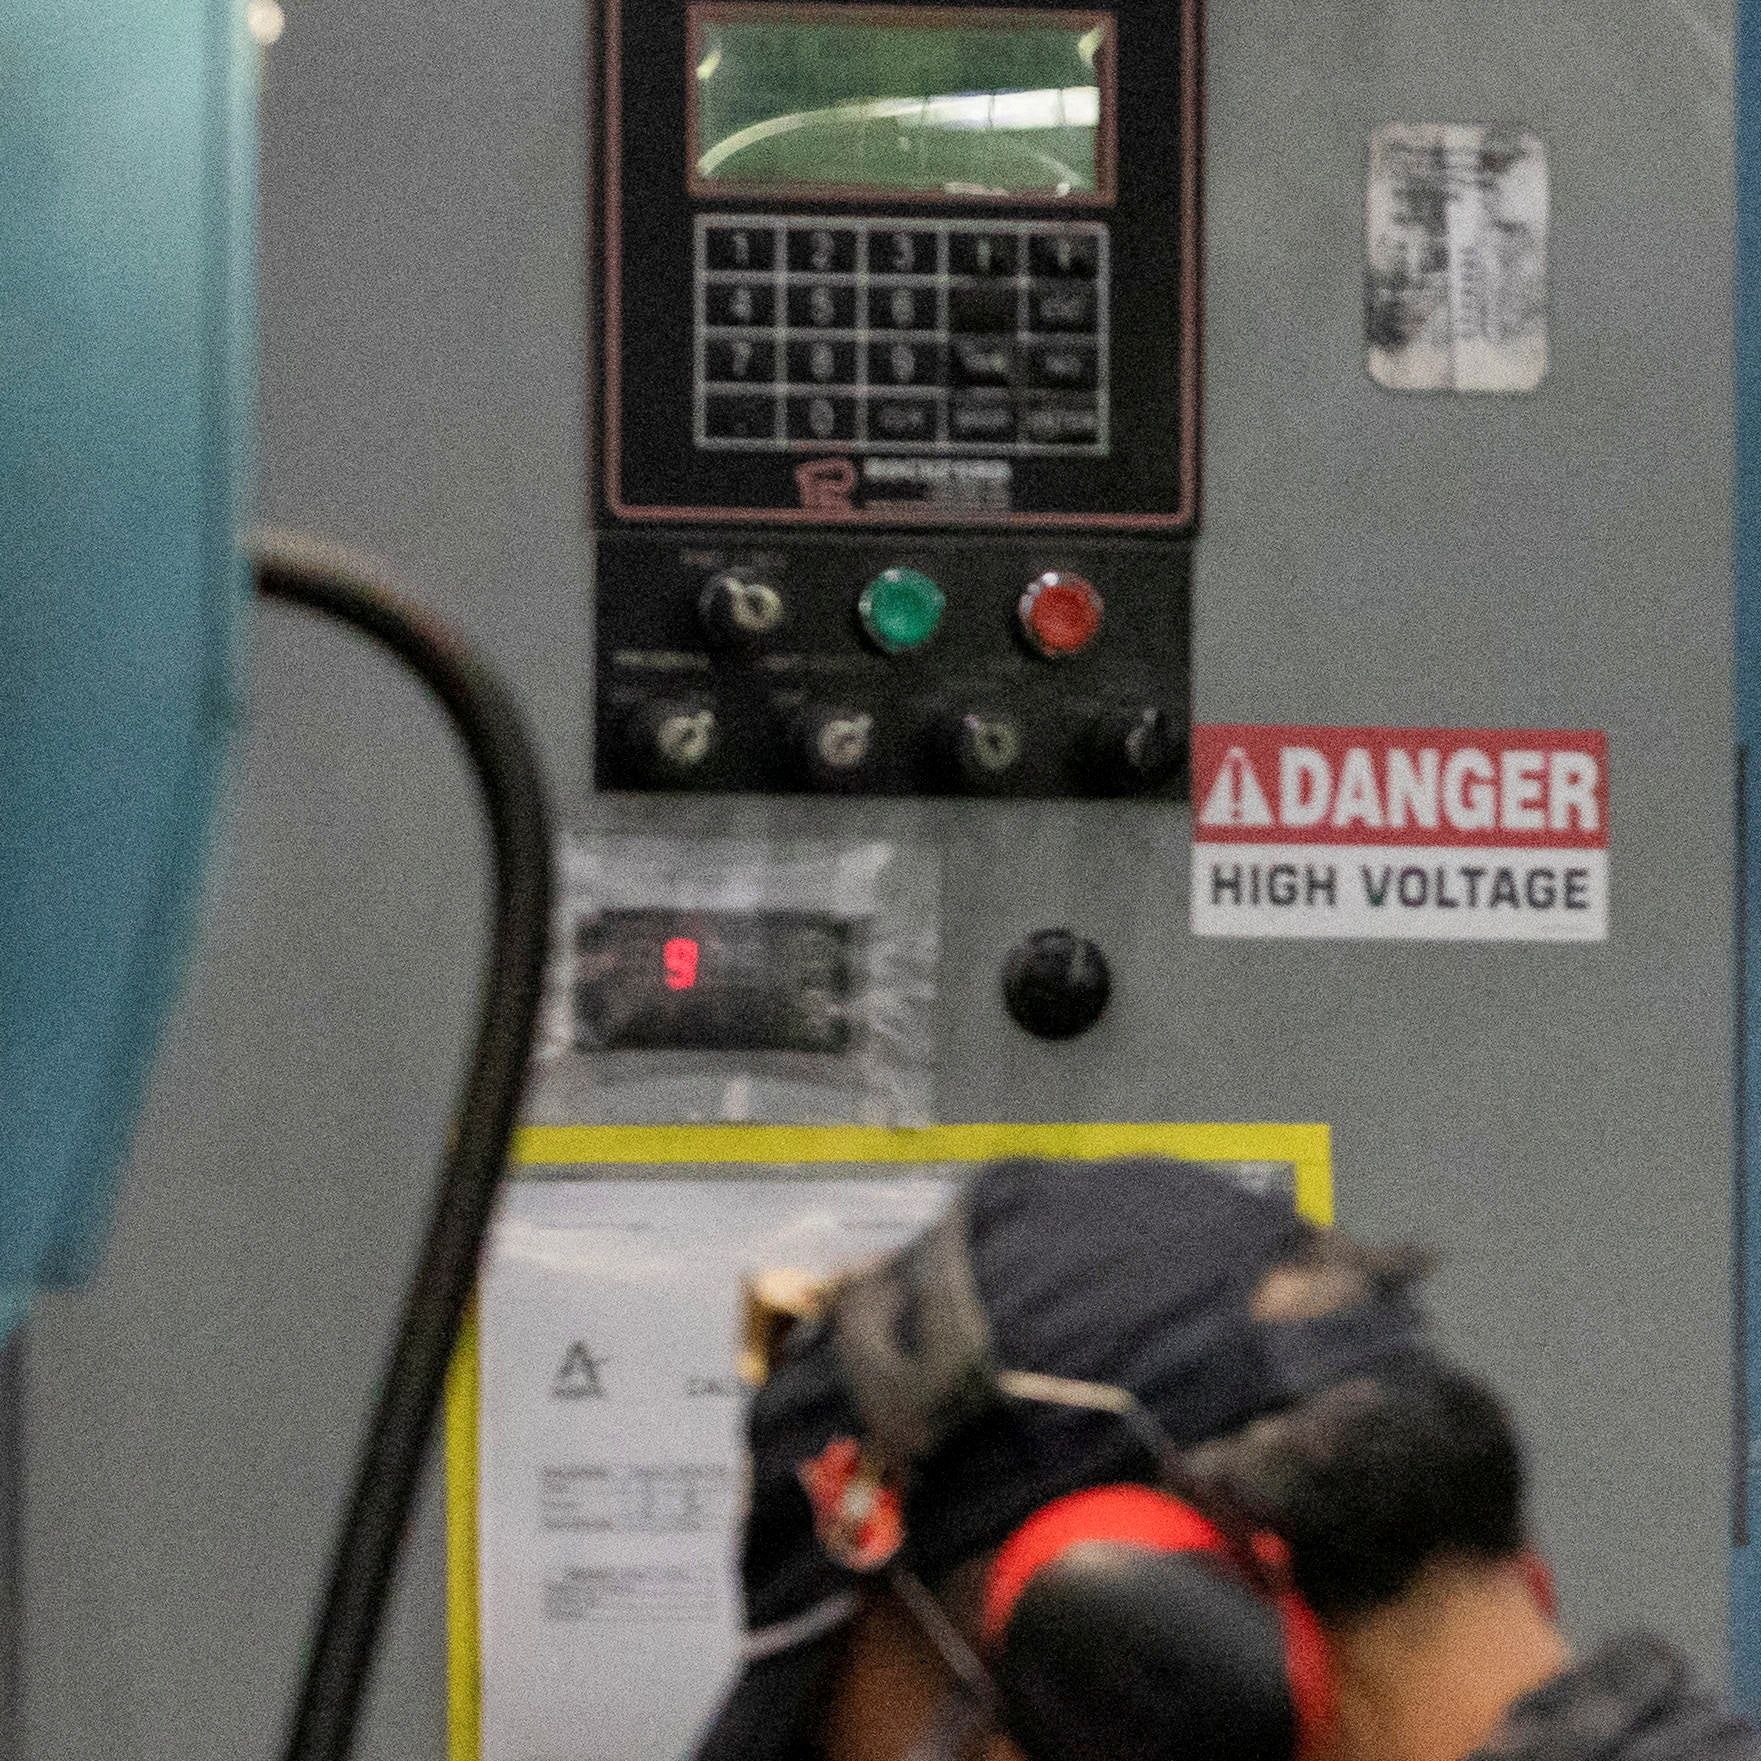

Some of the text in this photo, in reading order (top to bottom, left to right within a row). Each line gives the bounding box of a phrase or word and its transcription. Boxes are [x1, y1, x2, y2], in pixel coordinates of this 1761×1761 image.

[1280, 745, 1601, 832] DANGER
[1210, 863, 1592, 911] HIGH VOLTAGE
